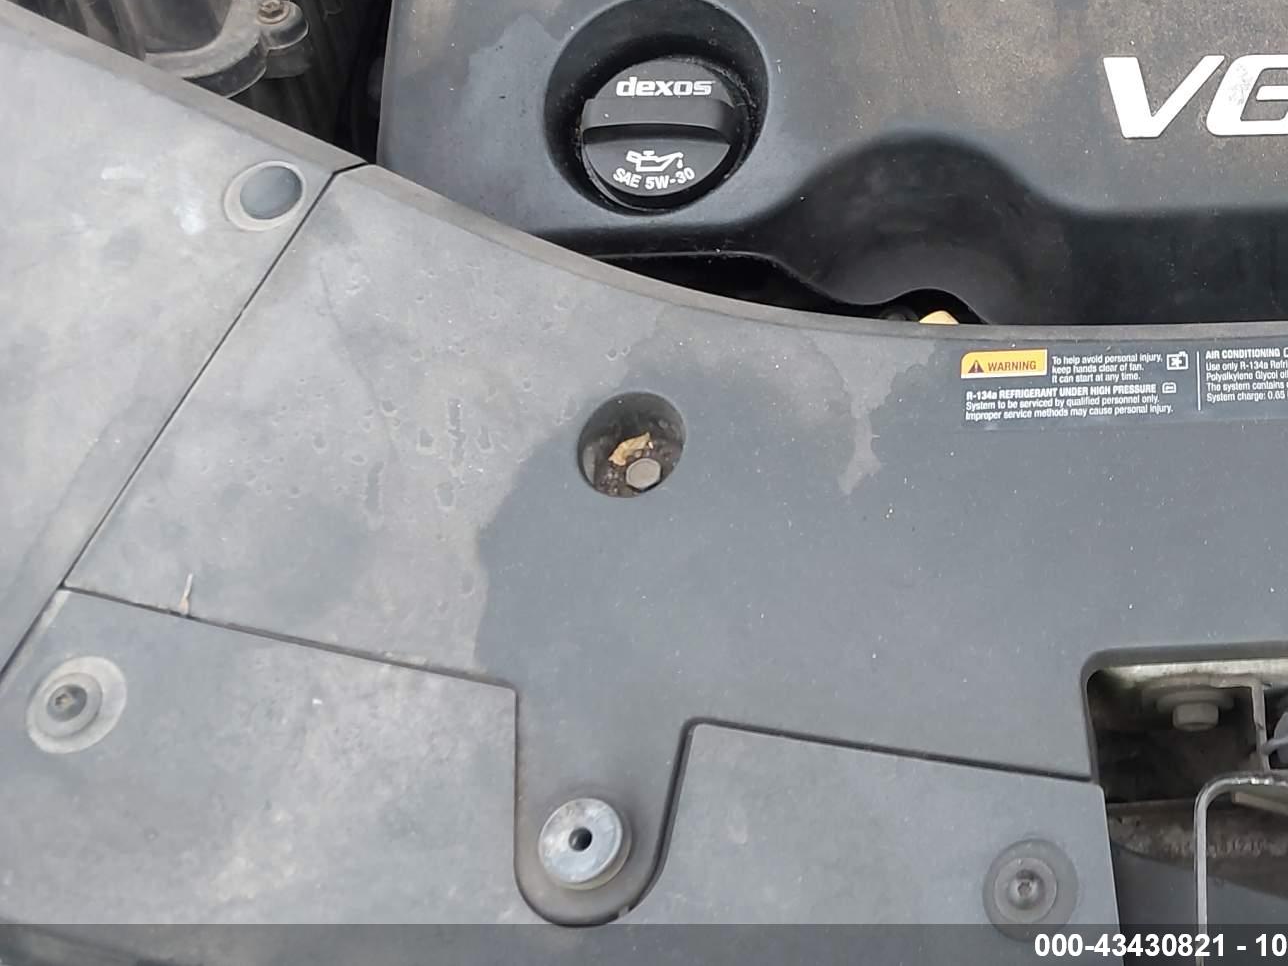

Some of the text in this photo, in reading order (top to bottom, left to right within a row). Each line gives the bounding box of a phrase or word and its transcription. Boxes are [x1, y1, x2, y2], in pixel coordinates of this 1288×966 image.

[616, 77, 713, 96] dexos
[613, 168, 695, 189] SAE 5W-30
[1052, 357, 1061, 365] To
[1064, 355, 1080, 365] help
[1082, 355, 1103, 364] avoid
[1105, 354, 1138, 365] personal
[1206, 349, 1280, 359] AIR CONDITIONING
[988, 361, 1036, 371] WARNING
[1052, 363, 1144, 375] keep hands clear of fan.
[1206, 362, 1220, 370] Use
[1222, 361, 1237, 371] only
[1240, 361, 1268, 369] R-134a
[1076, 374, 1093, 382] start
[1105, 373, 1119, 383] any
[1121, 373, 1140, 381] time.
[1206, 372, 1253, 382] Polyalkylene
[1256, 370, 1278, 380] Glycol
[1280, 370, 1288, 378] oil
[1207, 383, 1220, 391] The
[1223, 382, 1250, 392] system
[1252, 381, 1284, 390] contains
[966, 384, 1156, 401] R-134a REFRIGERANT UNDER HIGH PRESSURE
[1207, 393, 1235, 403] System
[1238, 392, 1265, 402] charge:
[966, 394, 1159, 411] System to be serviced by qualified personnel only.
[966, 404, 1173, 421] Improper service methods may cause personal injury.
